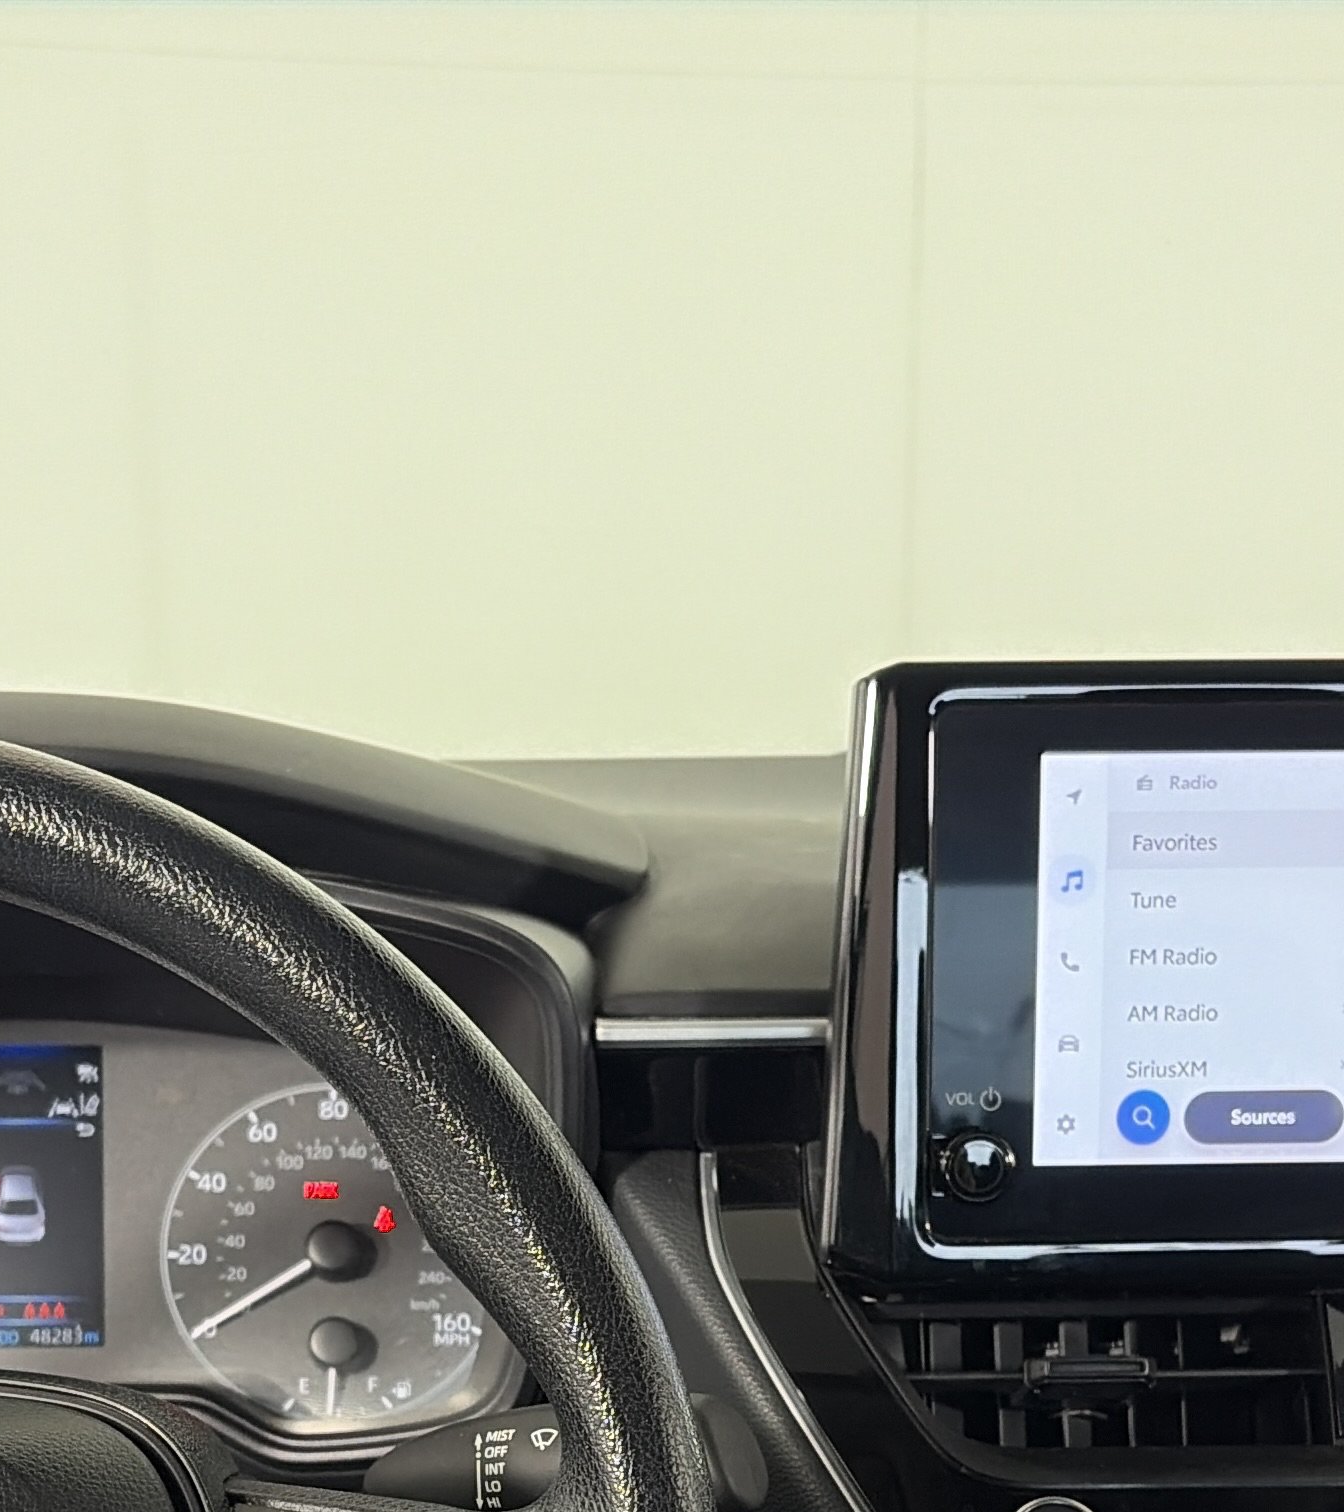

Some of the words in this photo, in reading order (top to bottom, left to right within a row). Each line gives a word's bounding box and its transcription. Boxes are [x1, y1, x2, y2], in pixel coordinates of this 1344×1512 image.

[1169, 775, 1218, 790] Radio
[1131, 833, 1218, 852] Favorites
[1130, 892, 1178, 909] Tune
[1129, 949, 1157, 965] FM
[1162, 947, 1218, 966] Radio
[1127, 1005, 1158, 1022] AM
[1164, 1003, 1219, 1022] Radio
[1126, 1060, 1208, 1079] SiriusXM
[945, 1092, 975, 1106] VOL
[318, 1099, 349, 1120] 80
[1230, 1107, 1297, 1126] Sources
[247, 1121, 278, 1143] 60
[307, 1144, 334, 1160] 120
[339, 1143, 367, 1160] 140
[276, 1154, 304, 1171] 100
[197, 1172, 227, 1193] 40
[233, 1201, 255, 1217] 60
[225, 1234, 246, 1249] 40
[178, 1243, 208, 1266] 20
[226, 1266, 247, 1282] 20
[418, 1270, 445, 1286] 240
[432, 1311, 471, 1332] 160
[433, 1331, 471, 1347] MPH
[299, 1377, 310, 1395] E
[367, 1375, 378, 1393] F
[485, 1429, 516, 1443] MIST
[484, 1445, 509, 1459] OFF
[485, 1461, 506, 1476] INT
[485, 1480, 502, 1493] LO
[486, 1496, 503, 1508] HI
